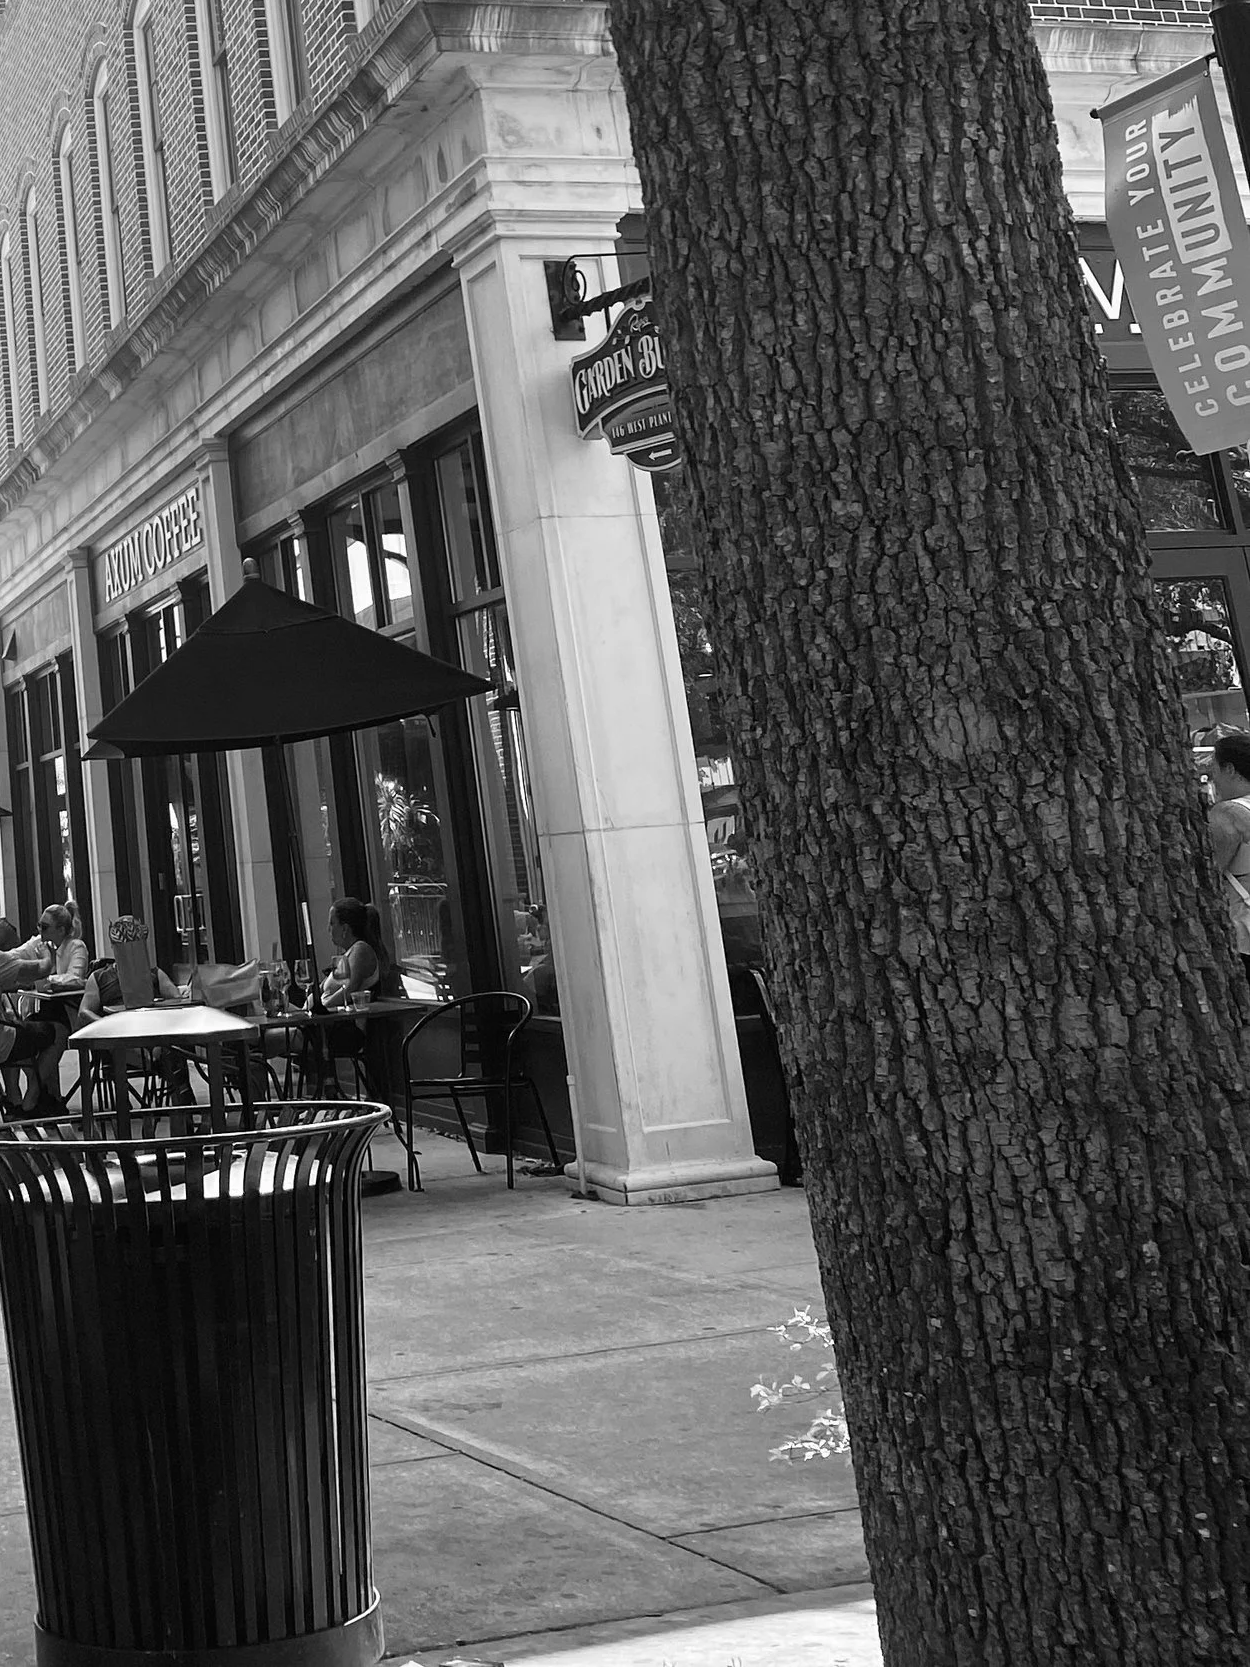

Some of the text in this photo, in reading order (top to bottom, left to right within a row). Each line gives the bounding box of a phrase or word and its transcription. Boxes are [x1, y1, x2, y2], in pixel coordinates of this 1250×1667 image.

[1125, 119, 1219, 417] CELEBRATE YOUR
[1158, 126, 1250, 407] COMMUNITY
[575, 345, 636, 414] GARDEN
[626, 418, 646, 434] WEST
[105, 487, 202, 603] AXUM COFFEE
